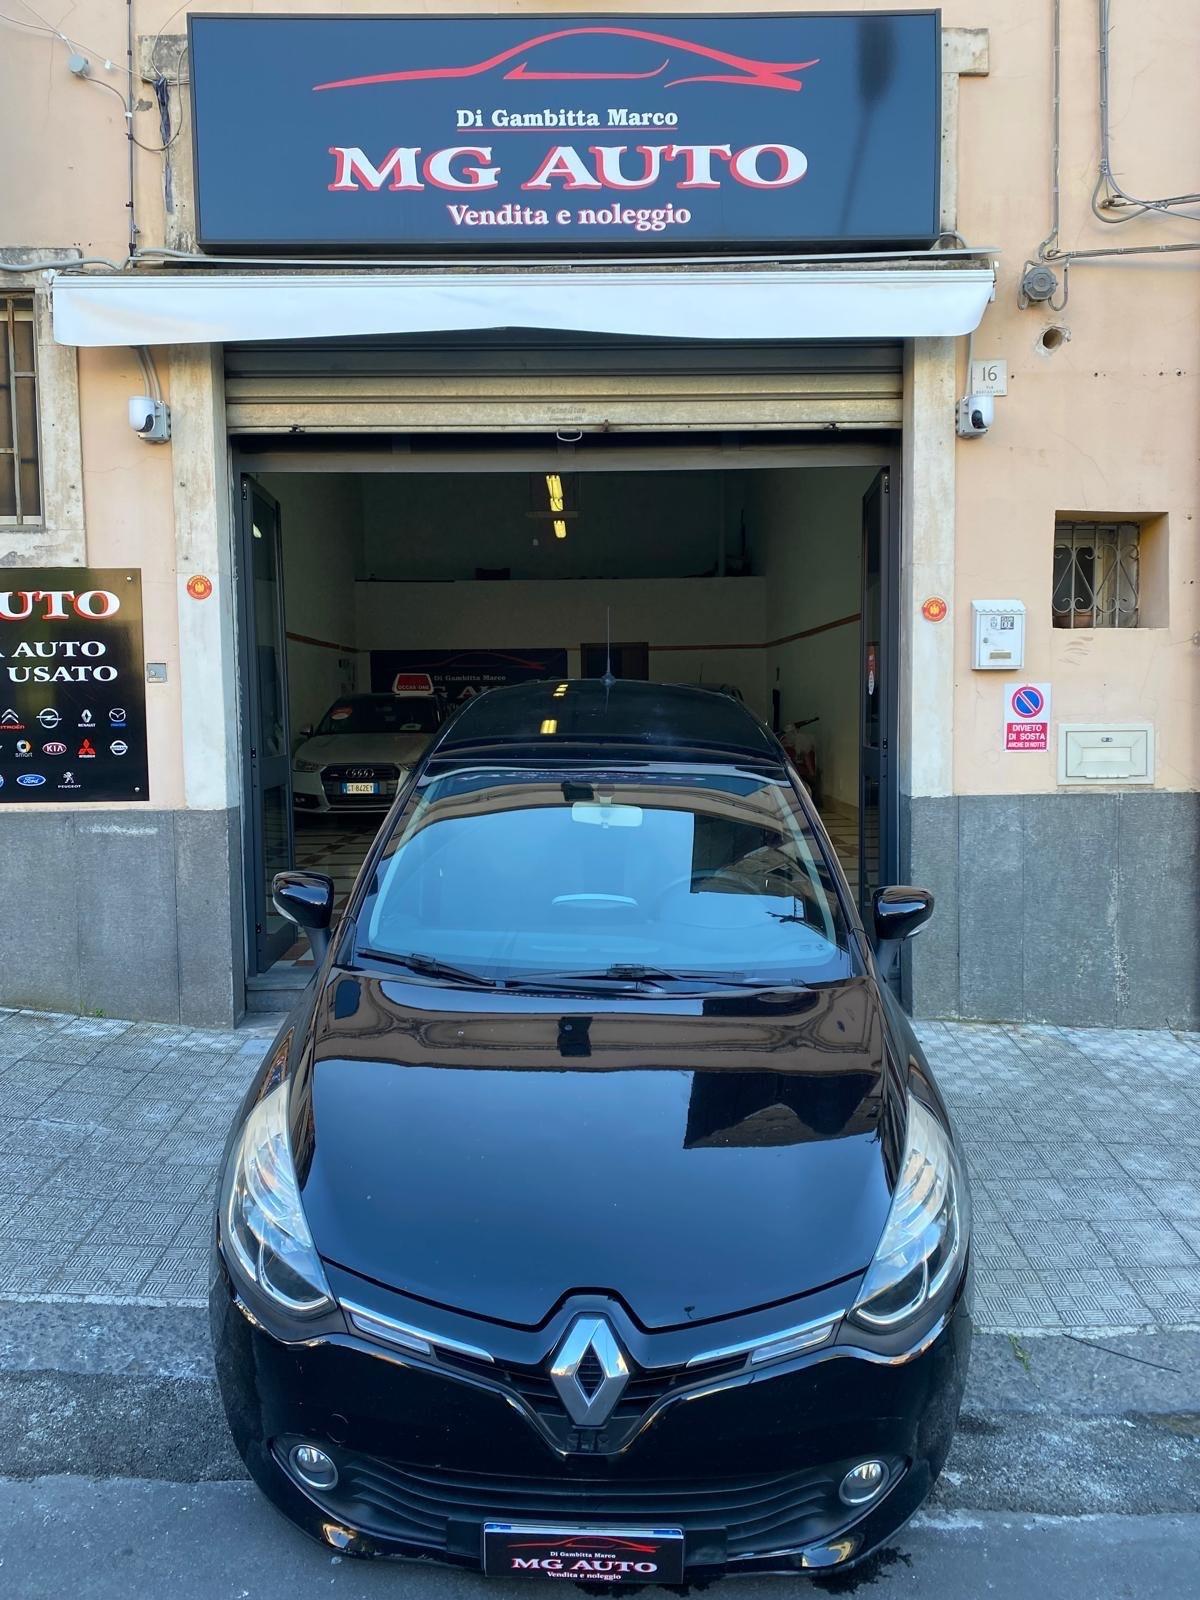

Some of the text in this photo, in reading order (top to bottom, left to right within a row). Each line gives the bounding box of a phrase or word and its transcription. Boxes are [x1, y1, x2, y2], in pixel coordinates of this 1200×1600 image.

[456, 108, 678, 127] Di Gambitta Marco
[328, 143, 808, 192] MG AUTO
[447, 203, 692, 232] Vendita e noleggio
[982, 365, 998, 381] 16
[11, 640, 106, 658] AUTO
[6, 666, 118, 682] USATO
[1012, 724, 1043, 732] DIVIETO
[1020, 732, 1046, 740] SOSTA
[22, 776, 40, 784] Ford
[511, 1557, 658, 1573] MG AUTO
[587, 1572, 622, 1581] noleggio
